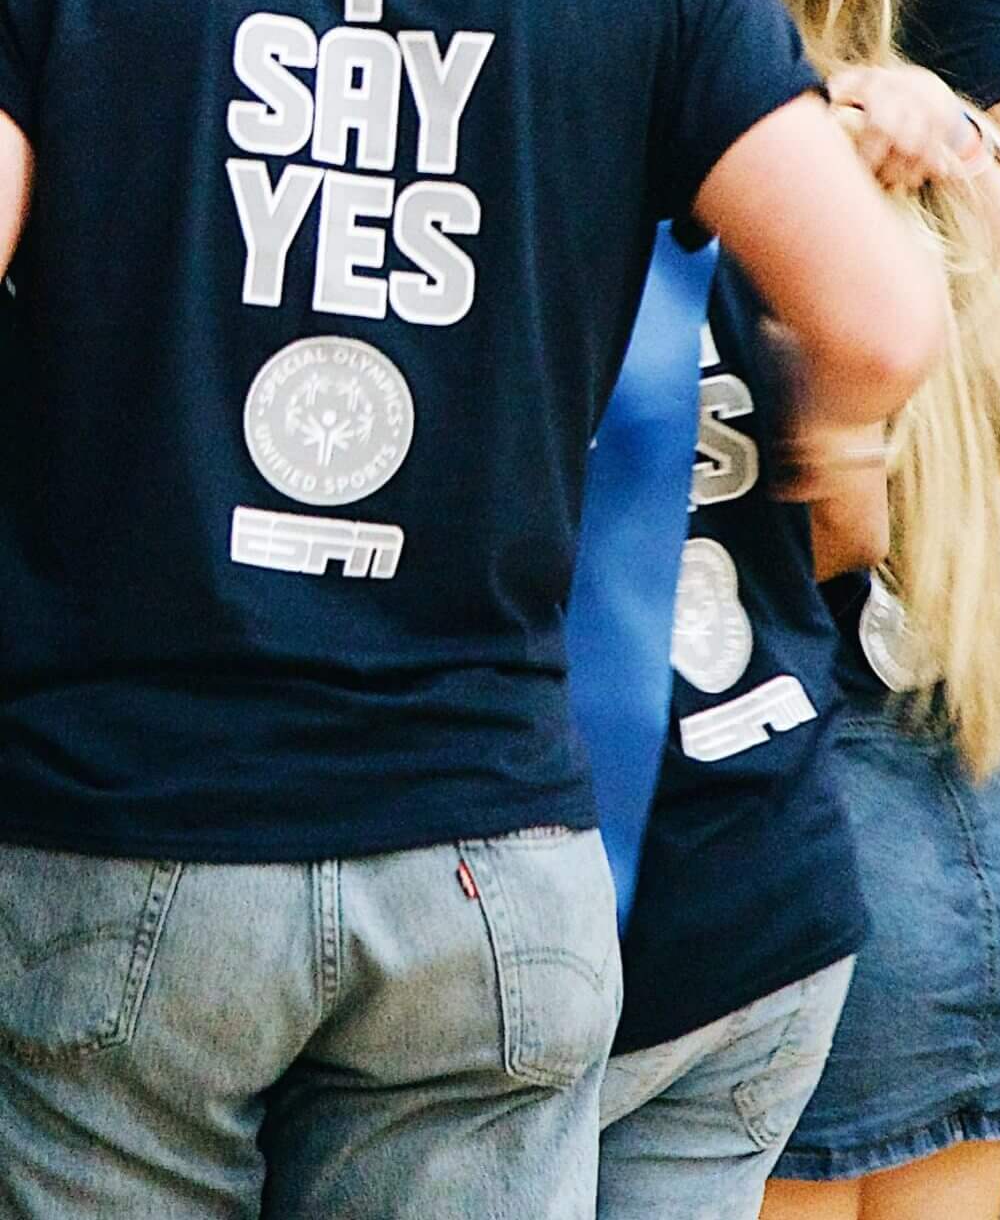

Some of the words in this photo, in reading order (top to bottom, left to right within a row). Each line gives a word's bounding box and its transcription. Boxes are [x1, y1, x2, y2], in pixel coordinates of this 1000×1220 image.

[227, 12, 495, 174] SAY
[225, 158, 481, 326] YES
[259, 346, 327, 406] SPECIAL
[333, 345, 404, 426] OLYMPICS
[254, 423, 316, 491] UNIFIED
[324, 442, 397, 495] SPORTS
[231, 506, 404, 579] ESPN
